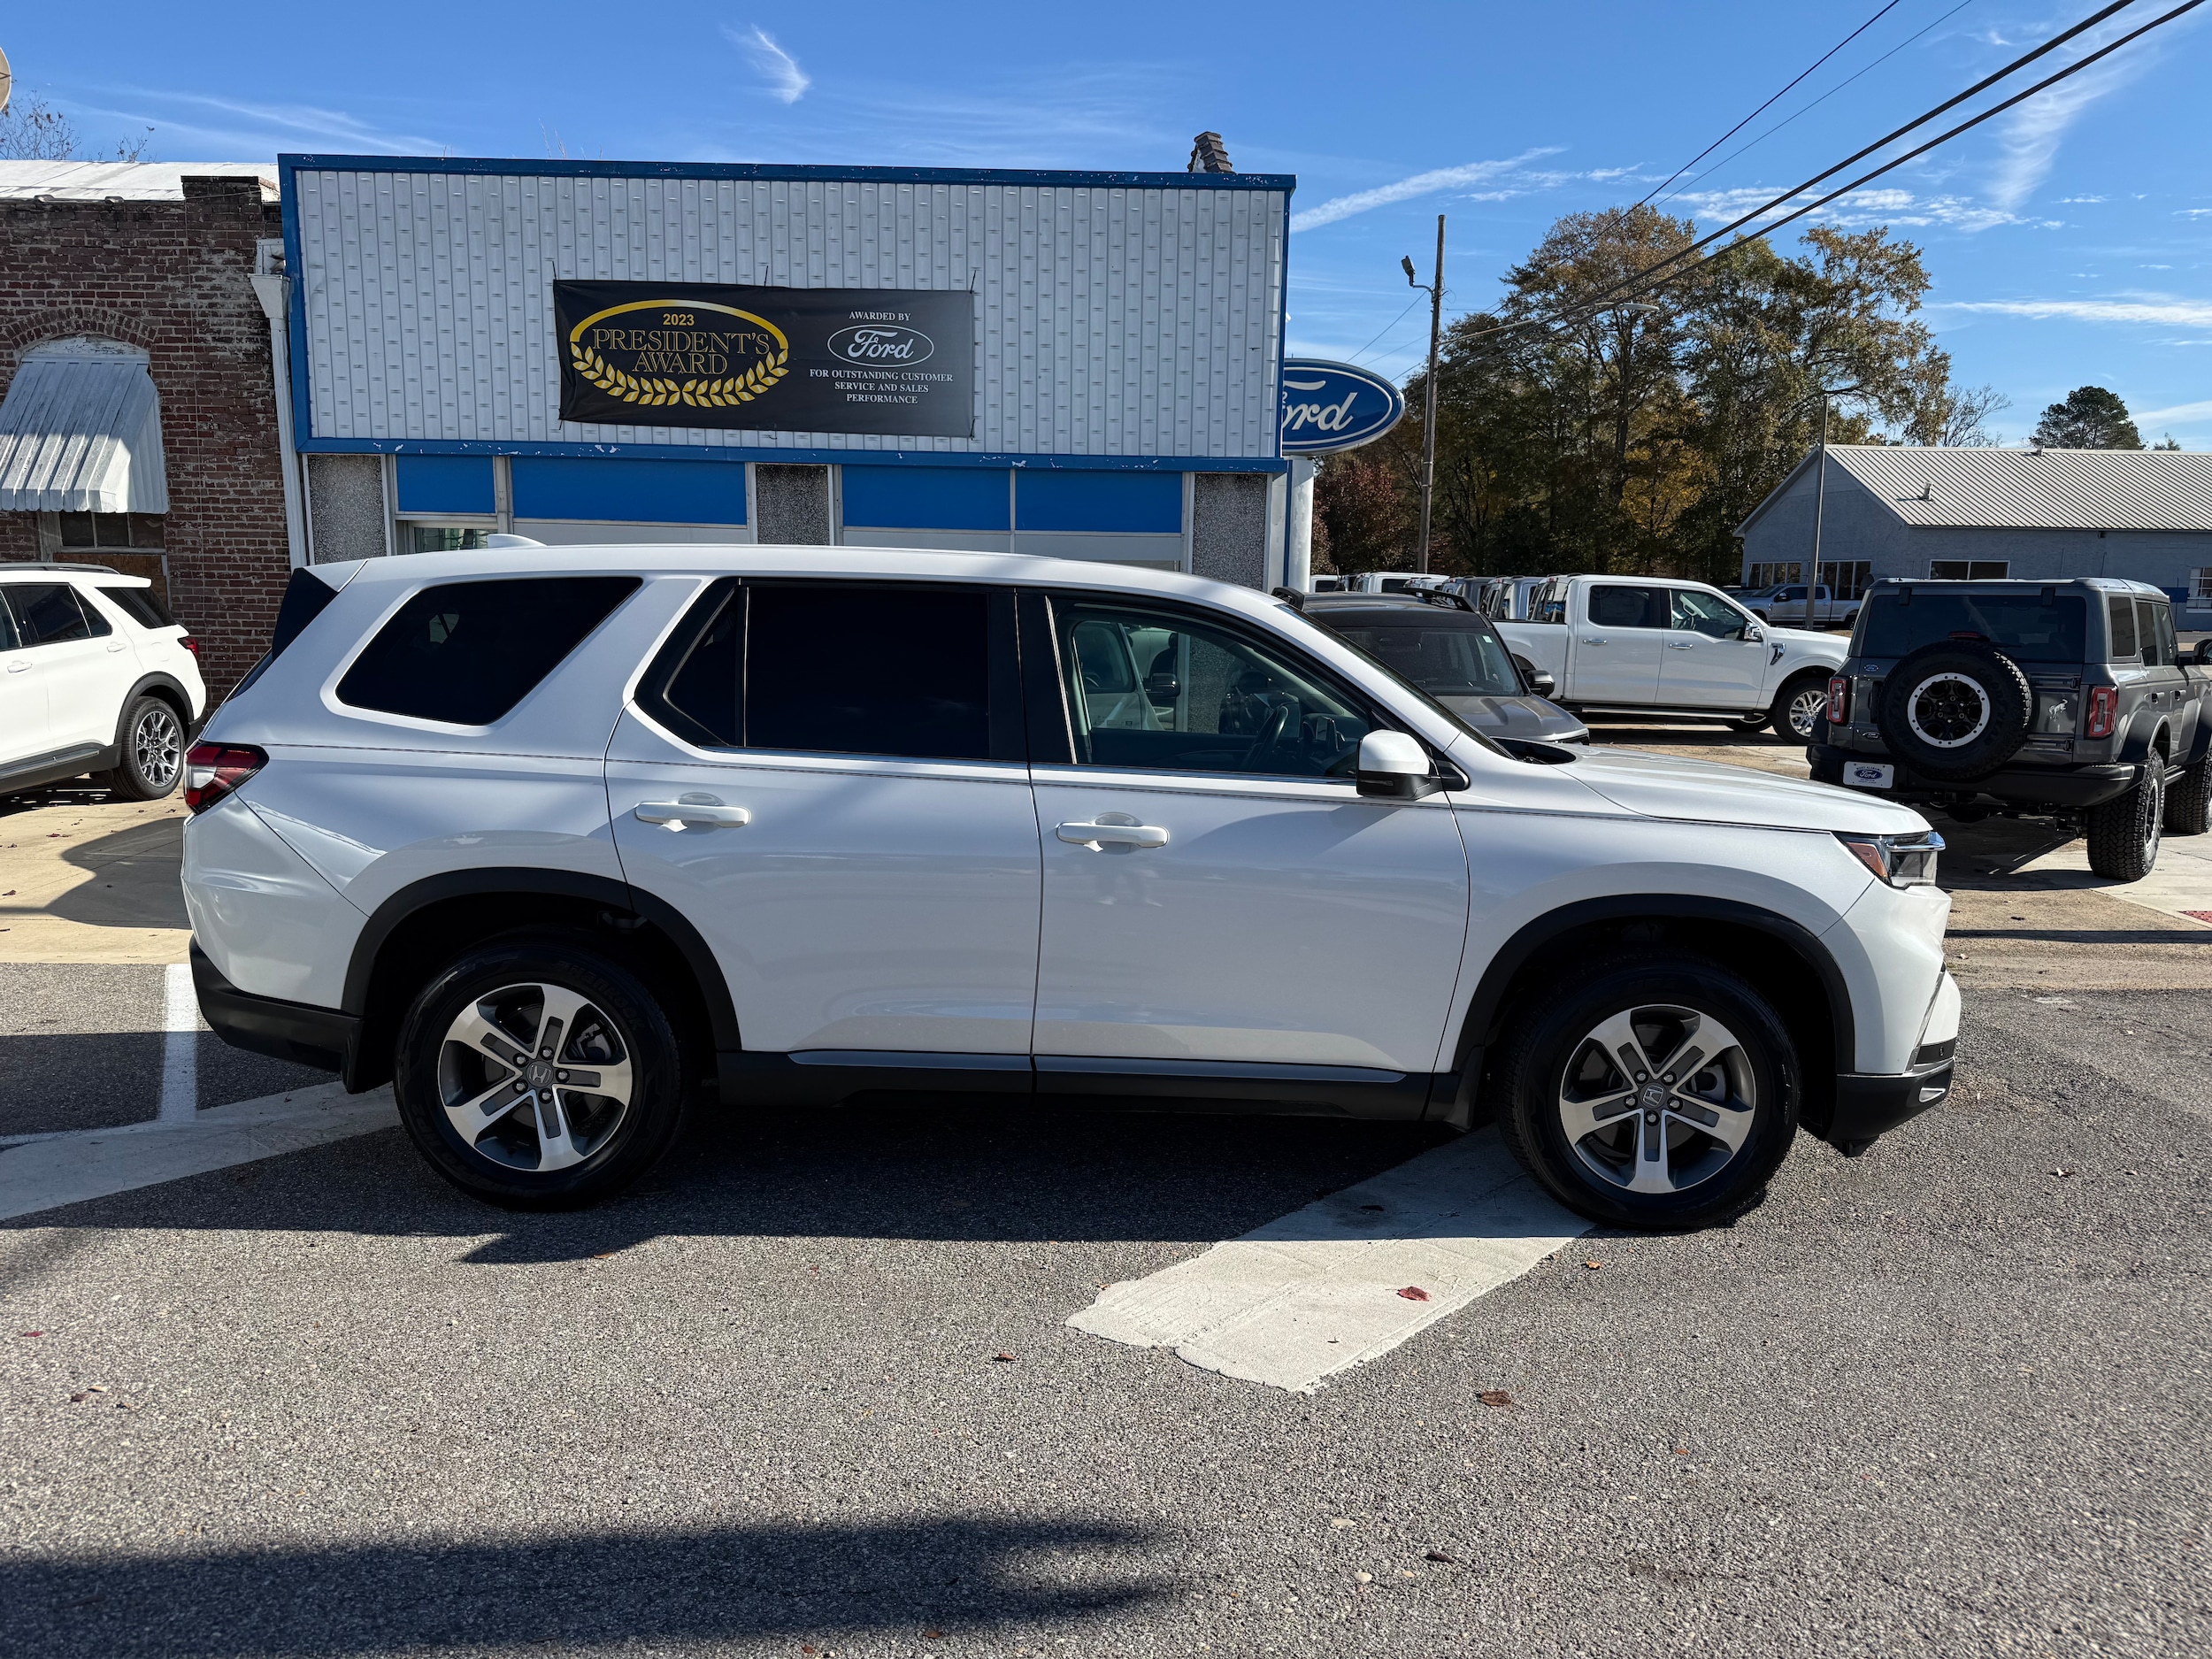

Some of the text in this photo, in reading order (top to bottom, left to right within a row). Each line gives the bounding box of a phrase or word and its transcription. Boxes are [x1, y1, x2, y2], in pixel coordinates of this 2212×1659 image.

[663, 313, 695, 326] 2023
[849, 311, 911, 321] AWARDED BY
[592, 328, 771, 355] PRESIDENT'S
[847, 329, 914, 359] Ford
[632, 351, 728, 375] AWARD
[809, 368, 954, 382] FOR OUTSTANDING CUSTOMER
[834, 381, 929, 393] SERVICE AND SALES
[846, 394, 918, 404] PERFORMANCE
[1282, 380, 1358, 431] rd
